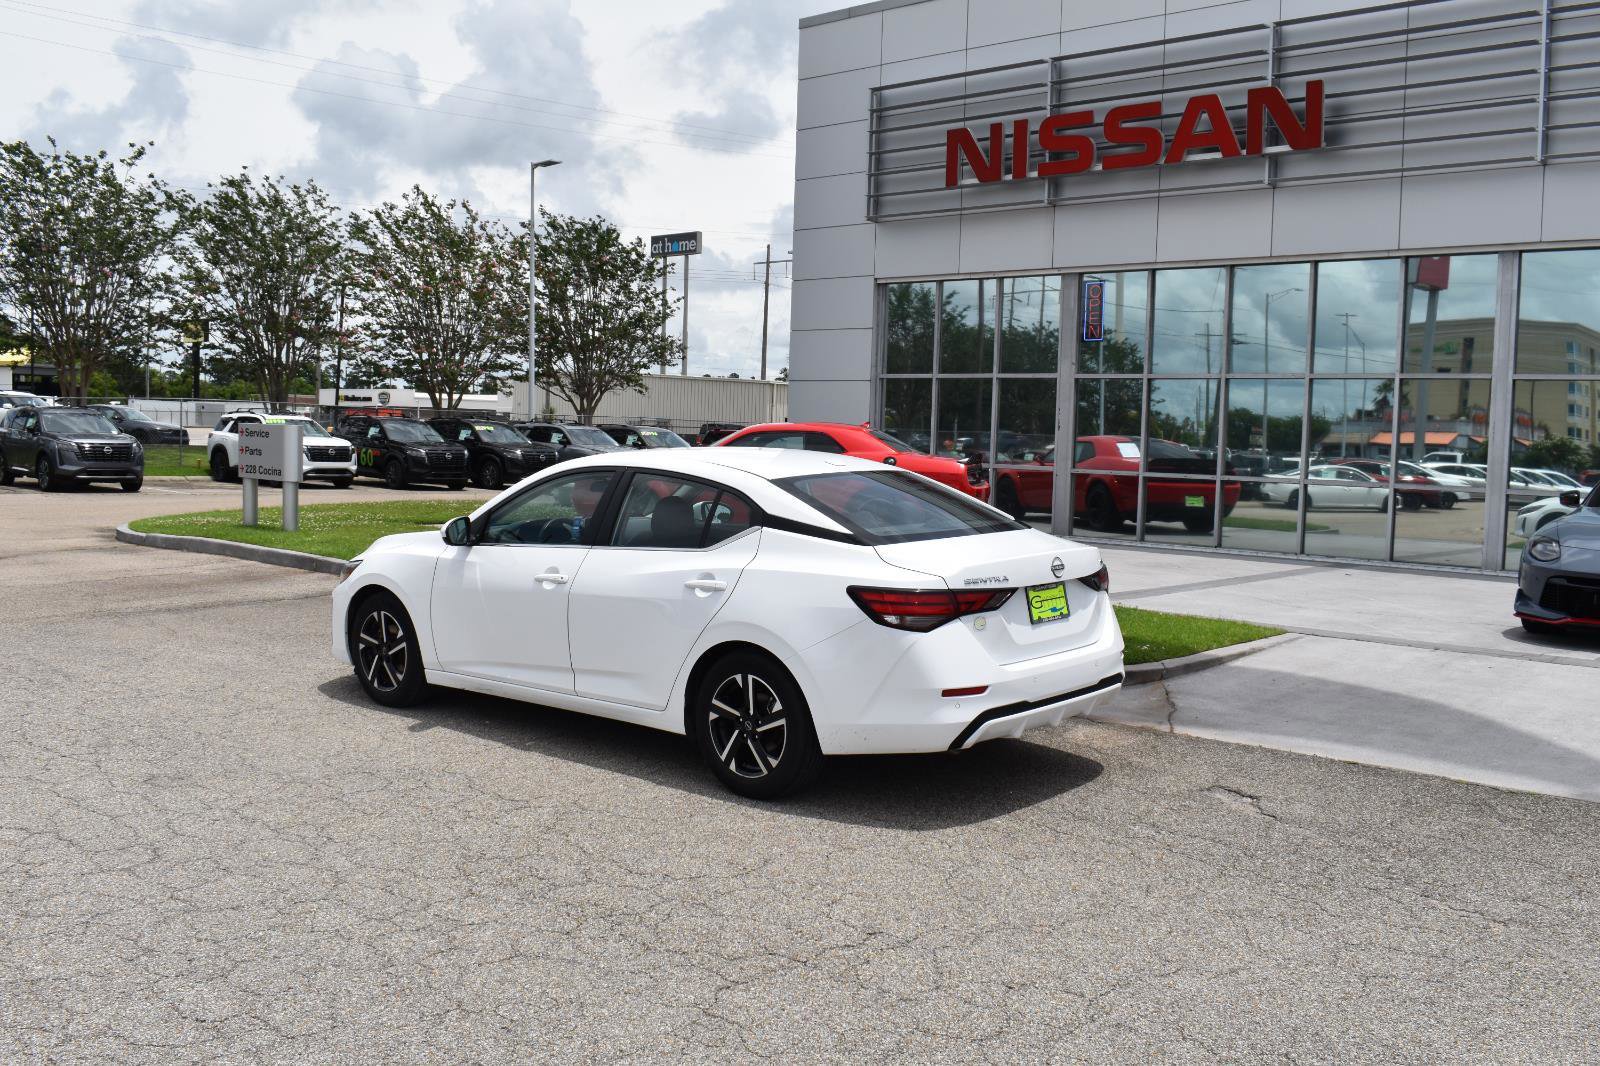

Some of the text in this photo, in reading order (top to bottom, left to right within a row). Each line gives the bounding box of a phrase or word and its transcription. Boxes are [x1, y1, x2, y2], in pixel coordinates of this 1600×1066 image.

[945, 80, 1324, 187] NISSAN
[651, 237, 696, 253] at home
[1089, 284, 1101, 338] OPEN
[245, 428, 270, 438] Service
[245, 446, 262, 456] Parts
[245, 465, 282, 476] 228 Cocina
